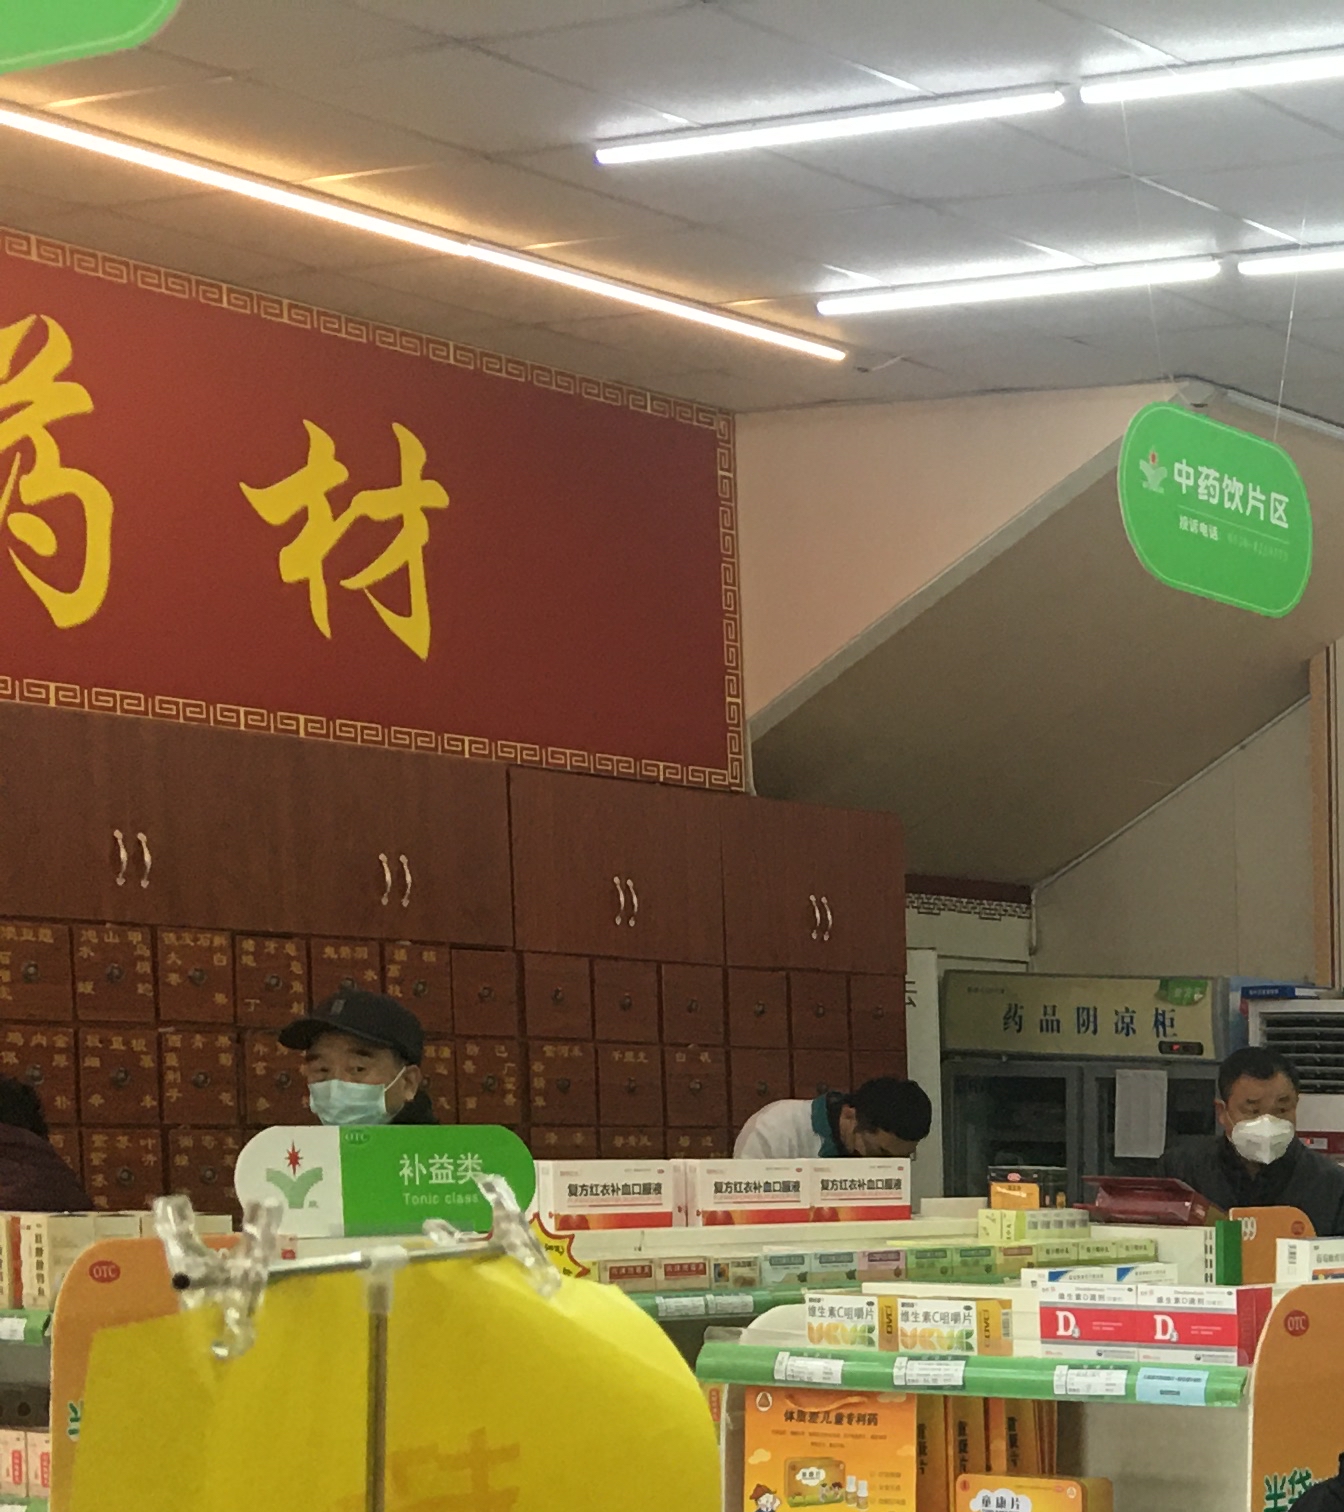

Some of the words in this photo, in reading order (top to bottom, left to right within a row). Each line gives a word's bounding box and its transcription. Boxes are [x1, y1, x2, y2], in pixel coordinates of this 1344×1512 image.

[0, 314, 449, 661] 药材
[1173, 458, 1290, 529] 中药饮片区
[1002, 1003, 1179, 1038] 药品阴凉柜
[399, 1152, 483, 1185] 补益类
[403, 1192, 438, 1205] Tonic
[445, 1192, 479, 1205] class
[93, 1265, 117, 1278] OTC
[808, 1305, 876, 1322] 维生素C咀嚼片
[900, 1308, 973, 1325] 维生素C咀嚼片
[1288, 1316, 1308, 1331] OTC
